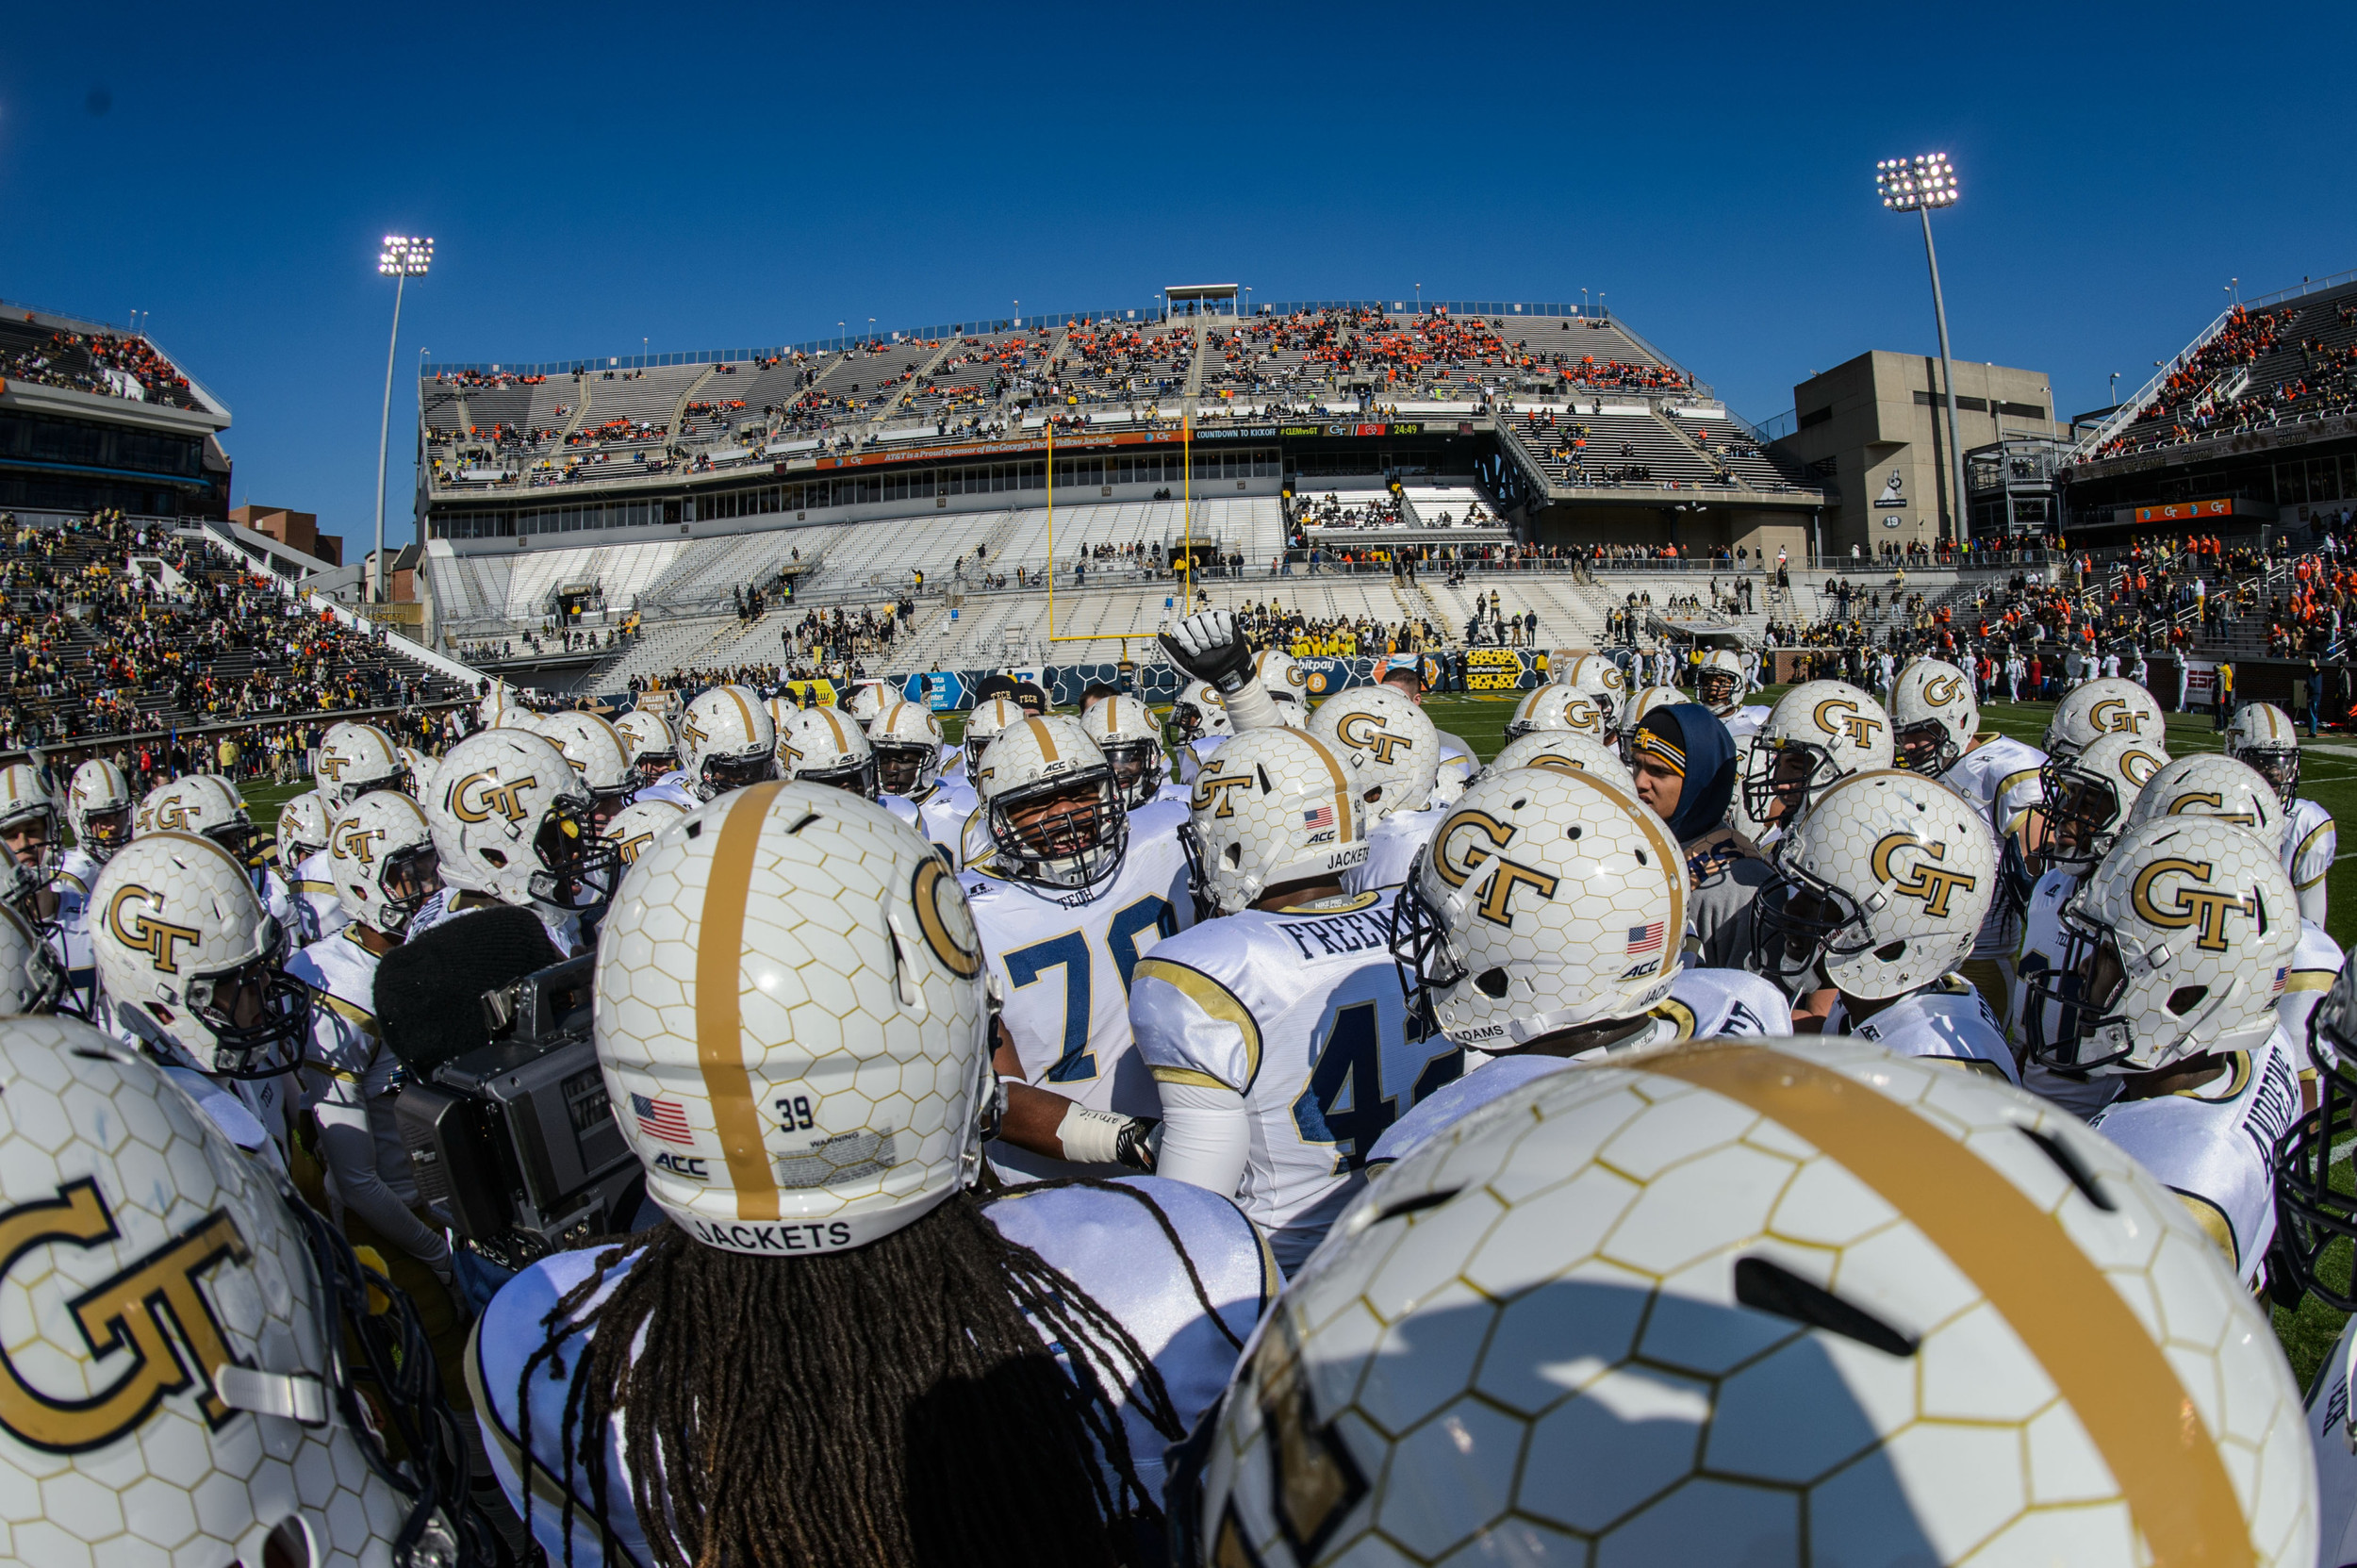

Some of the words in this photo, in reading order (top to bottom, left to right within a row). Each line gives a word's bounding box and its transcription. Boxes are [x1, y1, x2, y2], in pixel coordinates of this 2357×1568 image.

[1196, 430, 1238, 439] COUNTDOWN
[1240, 429, 1249, 438] TO
[1250, 428, 1277, 437] KICKOFF
[1280, 426, 1318, 436] #CLEMvsGT
[1394, 425, 1417, 435] 24:49
[2278, 432, 2307, 446] SHAW
[884, 452, 906, 461] AT&T
[919, 449, 943, 458] Proud
[944, 445, 976, 457] Sponsor
[977, 444, 985, 453] of
[986, 442, 997, 453] the
[997, 440, 1030, 454] Georgia
[1055, 437, 1082, 447] Yellow
[1082, 436, 1113, 446] Jackets
[2182, 449, 2213, 462] GUYON
[2102, 464, 2124, 477] HALL
[2126, 460, 2138, 472] OF
[2140, 456, 2166, 470] FAME
[1887, 517, 1899, 526] 19
[1297, 659, 1335, 672] bitpay
[990, 690, 1013, 701] TECH
[1018, 694, 1038, 704] TECH
[1923, 674, 1966, 708] GT
[1562, 700, 1600, 734] GT
[1814, 699, 1883, 750] GT
[2089, 699, 2150, 736] GT
[1336, 712, 1412, 765] GT
[318, 746, 350, 782] GT
[1044, 760, 1066, 773] ACC
[453, 767, 538, 824] GT
[1191, 760, 1254, 819] GT
[157, 796, 201, 831] GT
[333, 817, 386, 864] GT
[1305, 831, 1336, 845] ACC
[1433, 808, 1561, 930] GT
[1871, 831, 1977, 919] GT
[1057, 888, 1096, 912] TECH
[2131, 857, 2256, 952] GT
[109, 883, 201, 975] GT
[1618, 959, 1660, 981] ACC
[1454, 1024, 1505, 1043] ADAMS
[775, 1096, 814, 1132] 39
[809, 1131, 860, 1148] WARNING
[652, 1152, 709, 1177] ACC
[694, 1221, 852, 1251] JACKETS
[0, 1176, 253, 1454] GT
